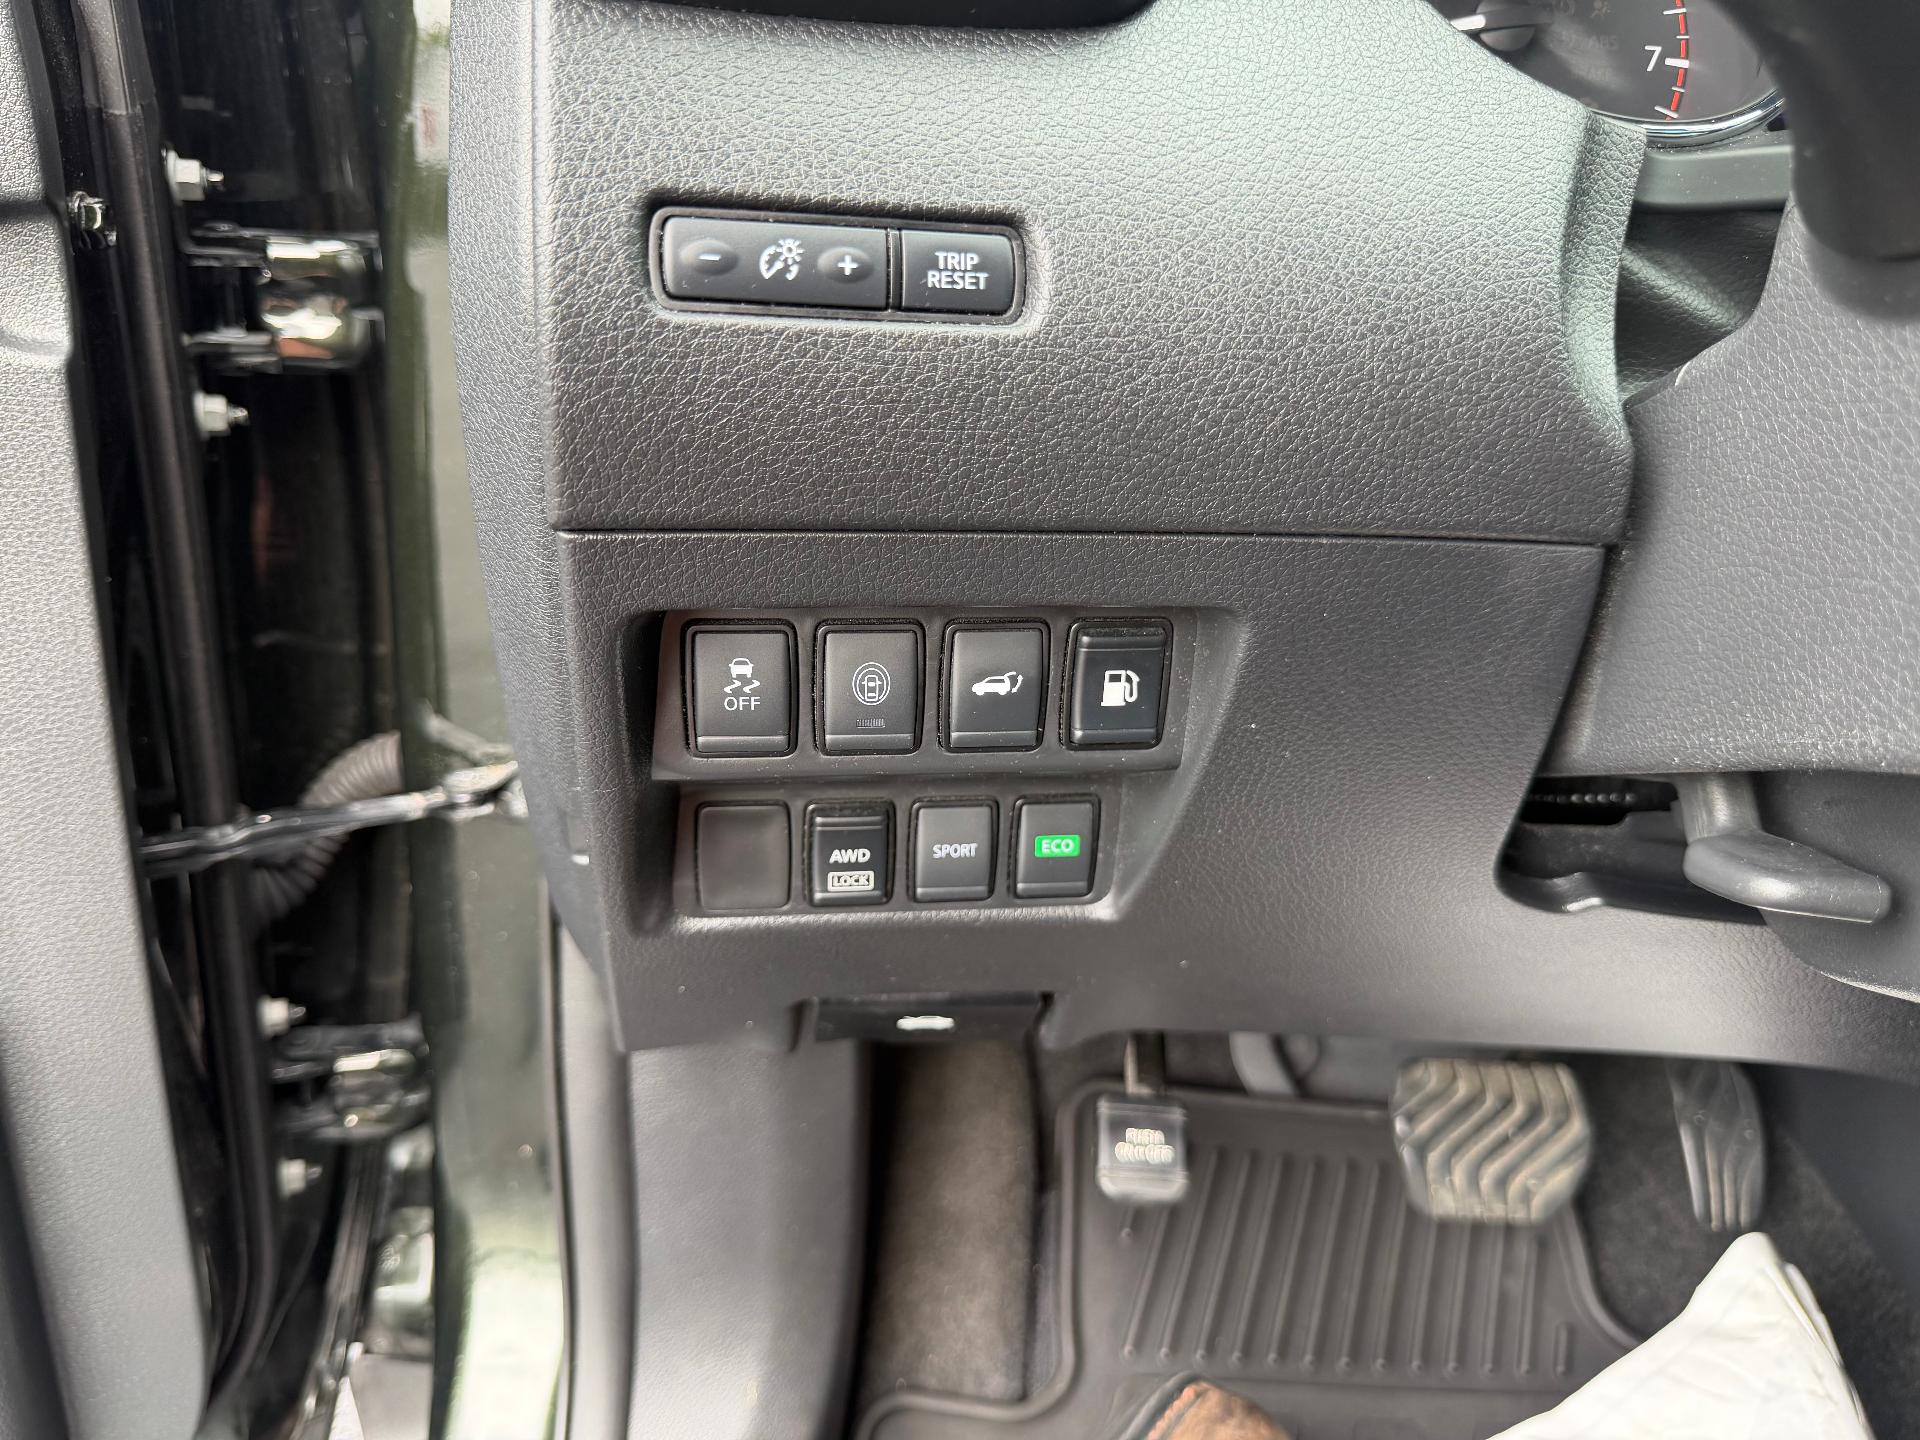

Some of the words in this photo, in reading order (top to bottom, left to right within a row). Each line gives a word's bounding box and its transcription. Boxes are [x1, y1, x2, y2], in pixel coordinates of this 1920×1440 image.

[1644, 45, 1663, 72] 7
[935, 251, 979, 271] TRIP
[926, 269, 989, 291] RESET
[723, 696, 761, 711] OFF
[932, 843, 977, 859] SPORT
[1041, 838, 1074, 854] ECO
[828, 848, 870, 865] AWD
[832, 874, 871, 888] LOCK
